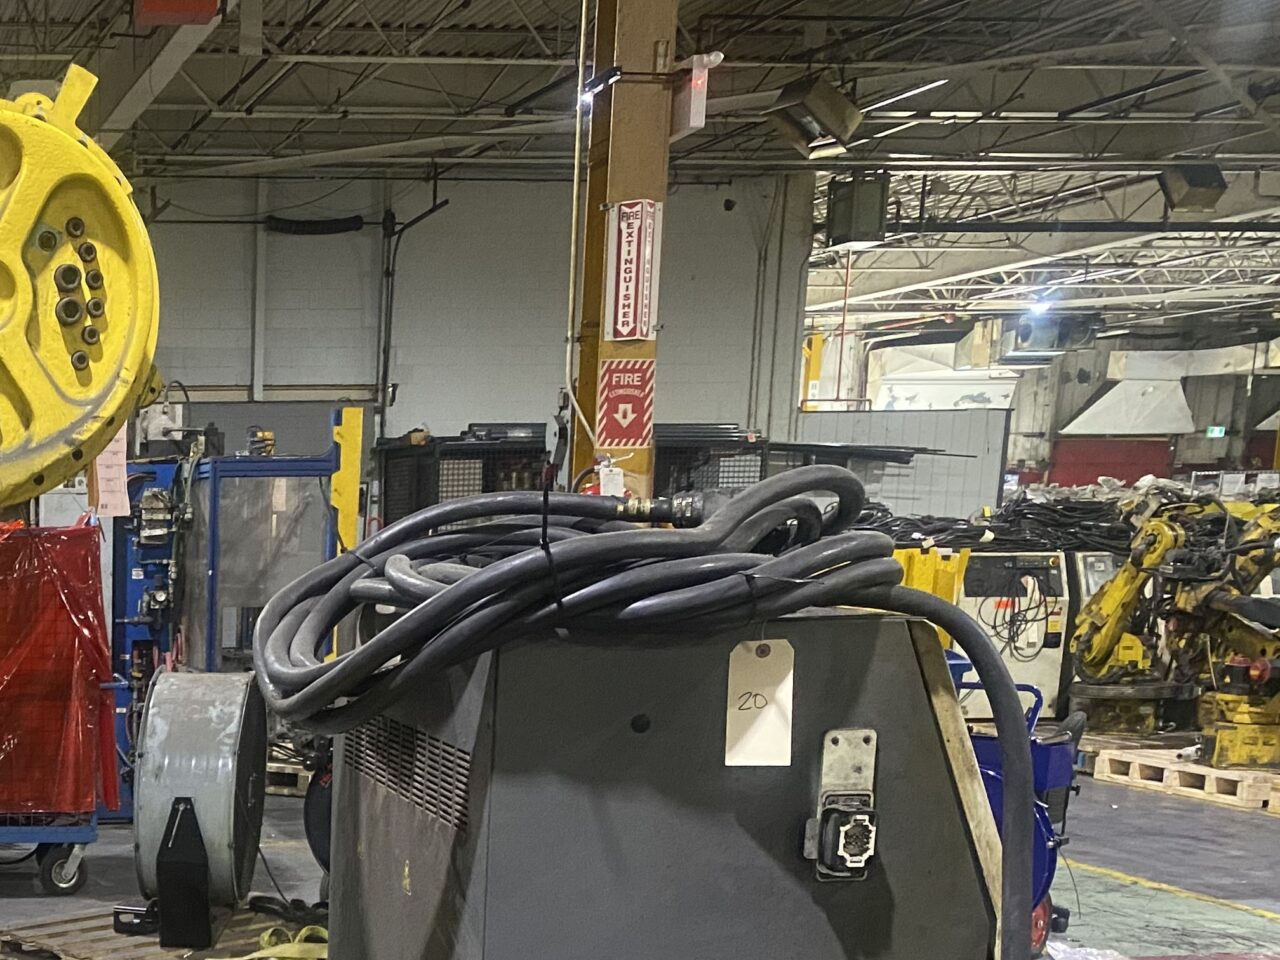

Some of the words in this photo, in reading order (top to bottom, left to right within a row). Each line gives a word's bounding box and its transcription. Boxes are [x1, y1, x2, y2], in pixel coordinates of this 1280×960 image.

[620, 210, 640, 221] FIRE
[621, 222, 635, 327] EXTINGUISHER
[612, 373, 642, 385] FIRE
[737, 691, 769, 711] 20
